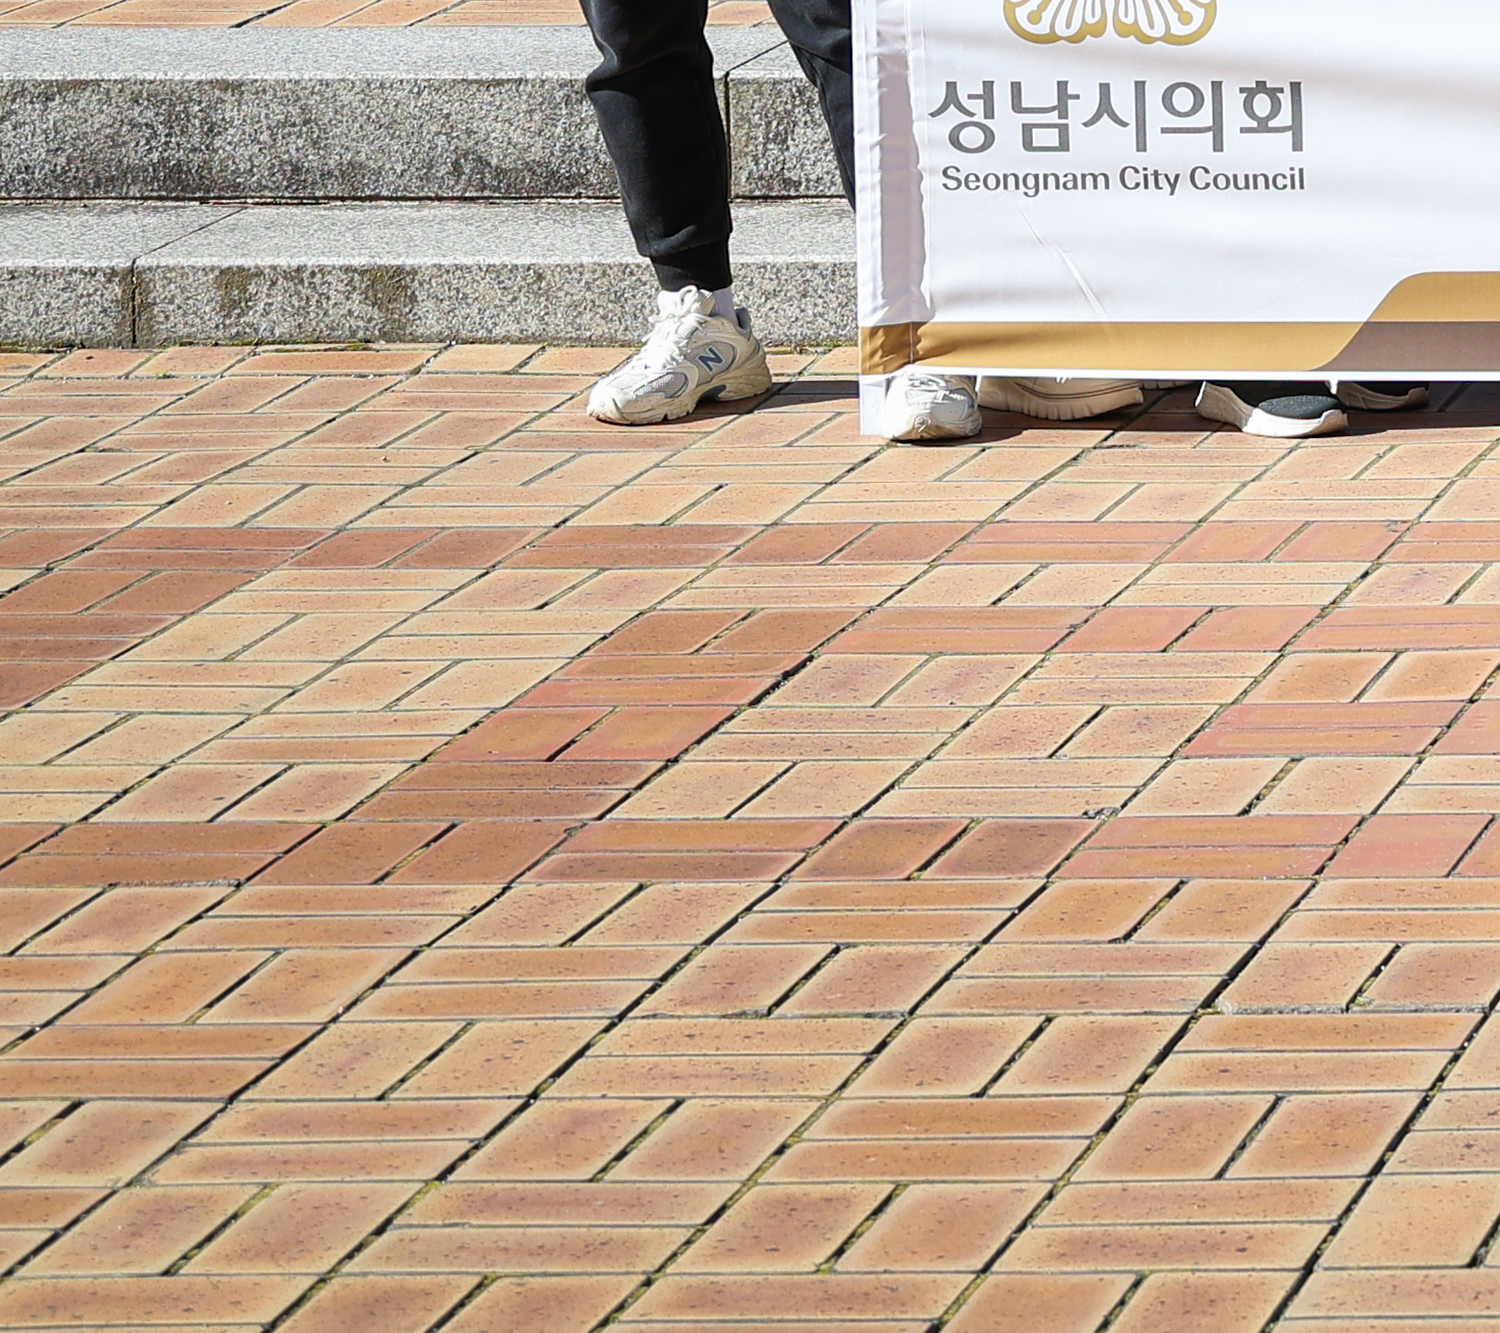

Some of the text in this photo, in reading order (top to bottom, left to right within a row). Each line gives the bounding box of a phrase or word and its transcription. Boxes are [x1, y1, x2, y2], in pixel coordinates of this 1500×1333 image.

[927, 79, 1304, 154] 성남시의회
[941, 165, 1306, 198] Seongnam City Council
